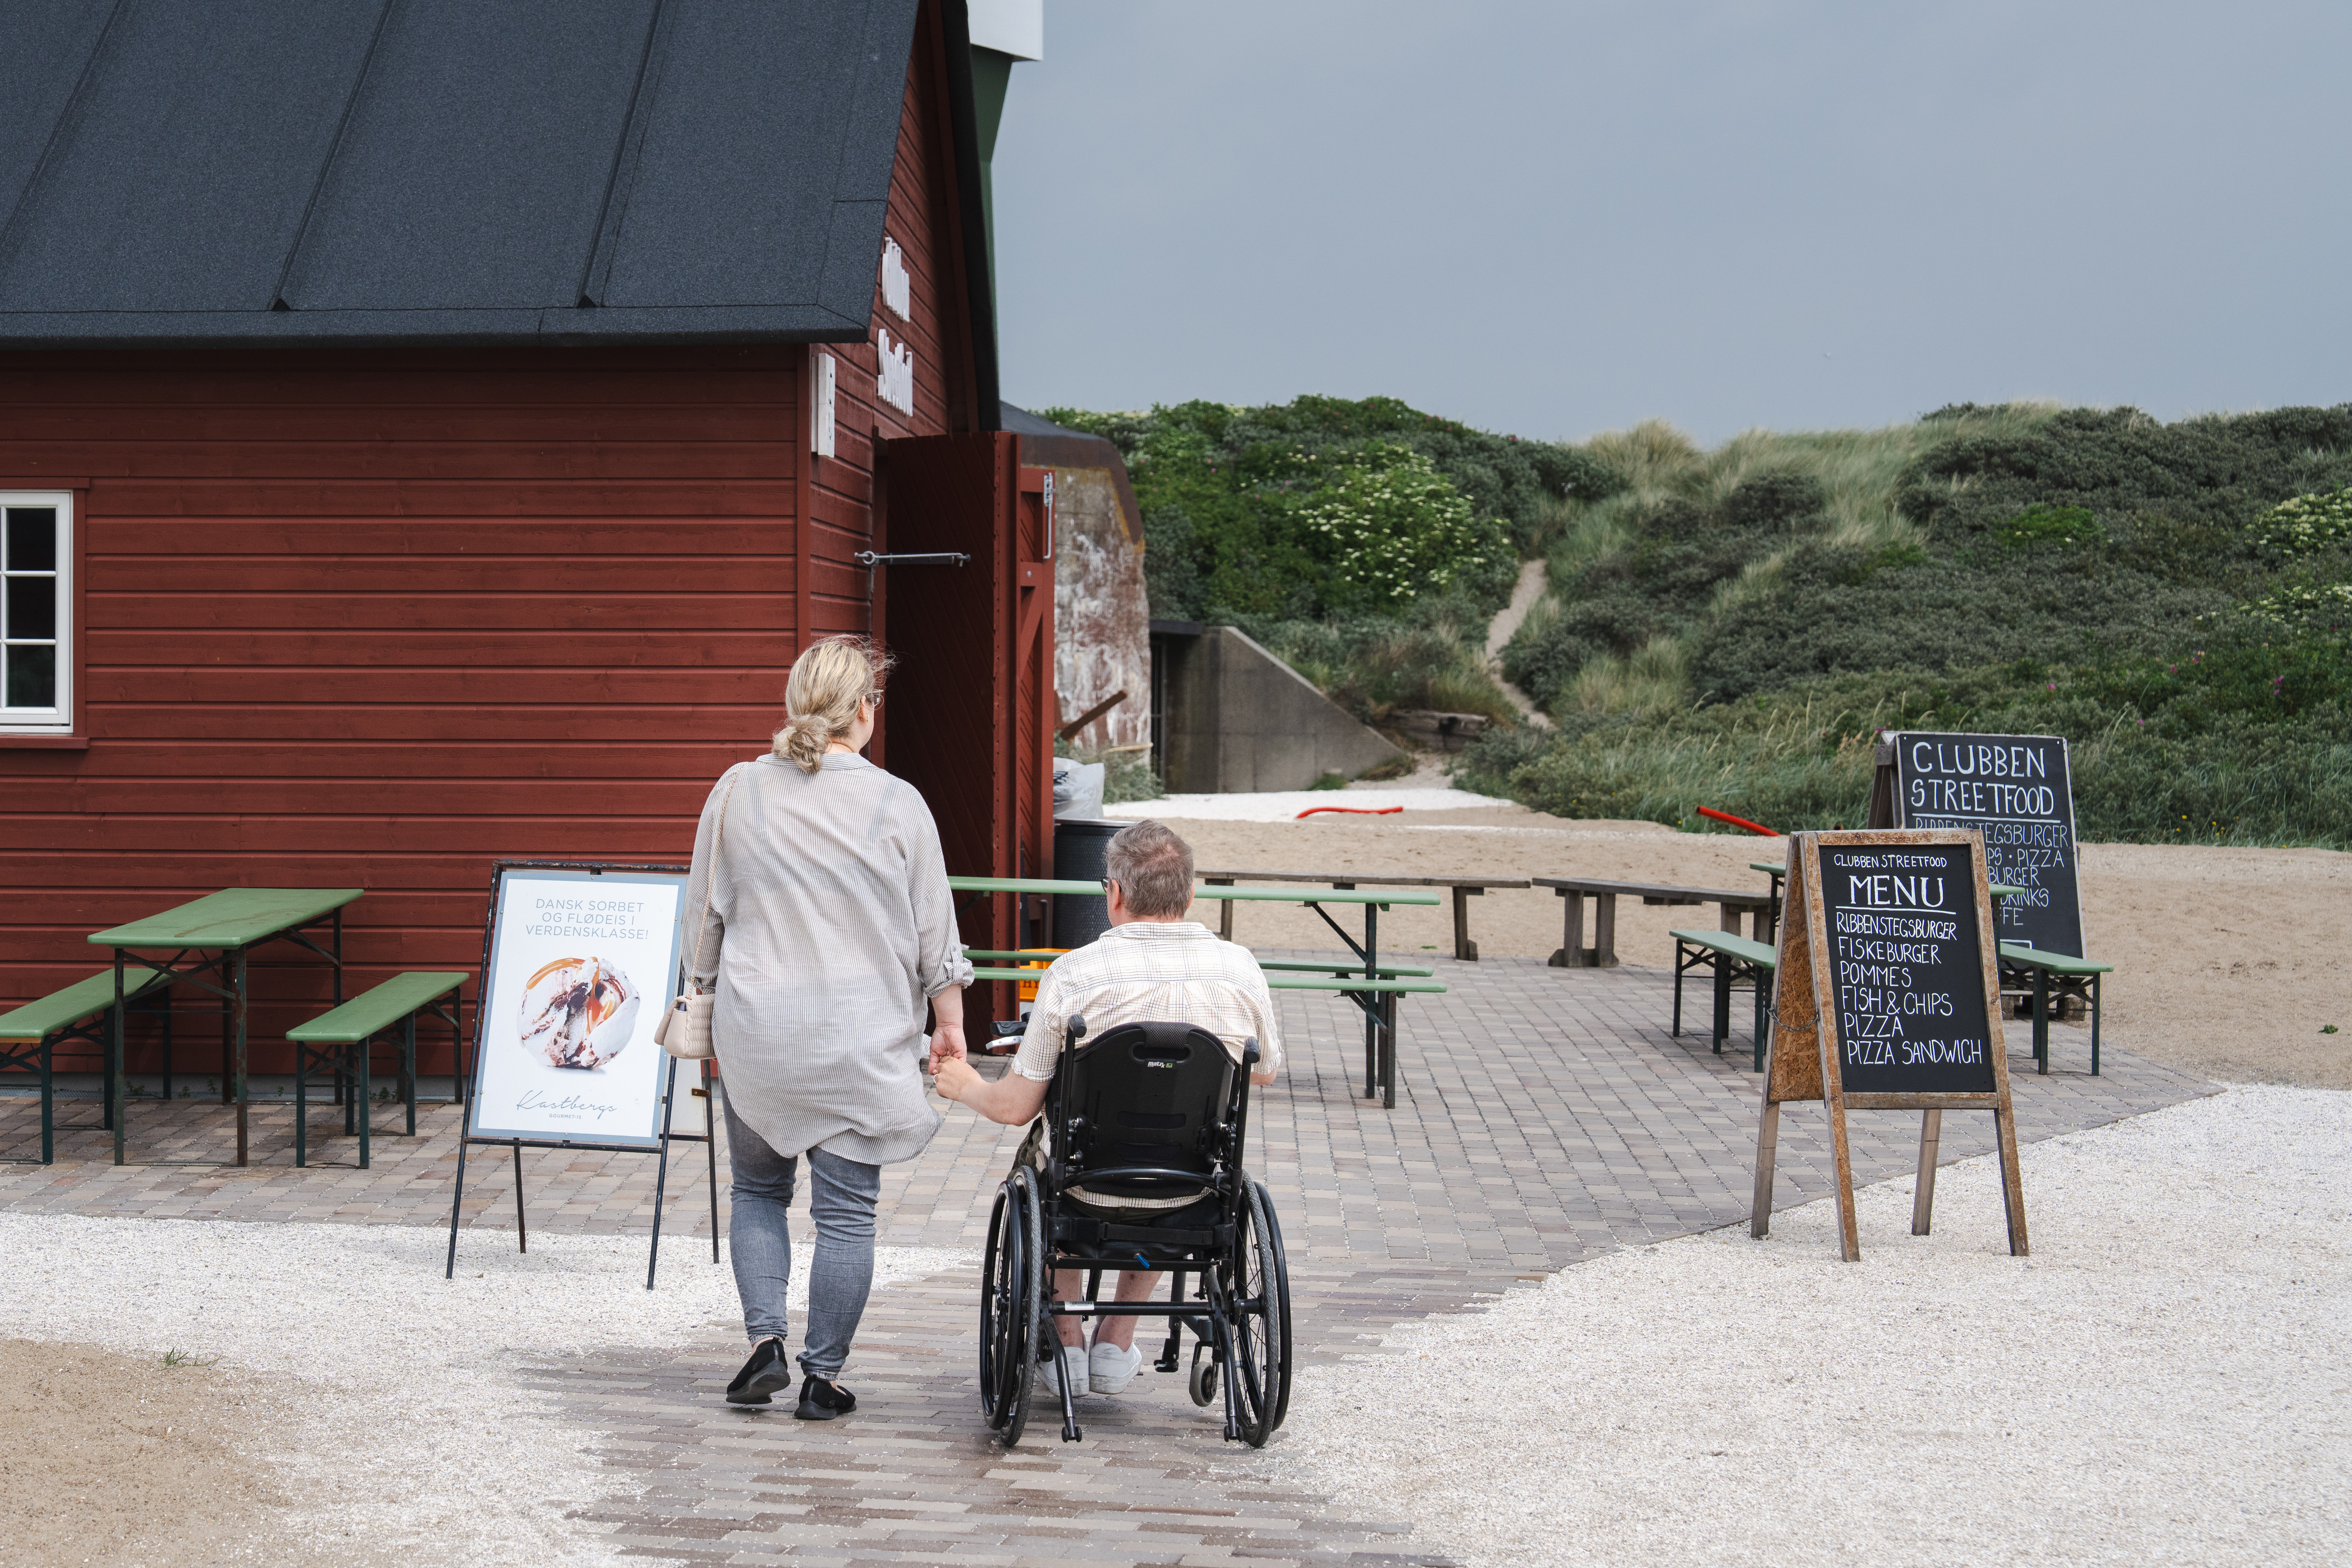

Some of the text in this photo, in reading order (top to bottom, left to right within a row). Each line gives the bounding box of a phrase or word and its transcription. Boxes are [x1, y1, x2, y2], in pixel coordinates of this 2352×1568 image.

[1912, 741, 2045, 778] CLUBBEN
[1911, 778, 2054, 815] STREETFOOD
[1834, 854, 1947, 868] CLUBBEN STREETFOOD
[2017, 848, 2065, 868] PIZZA
[1849, 875, 1944, 907] MENU
[536, 899, 645, 912] DANSK SORBET
[542, 912, 635, 925] OG FLØDEIS I
[526, 924, 648, 939] VERDENSKLASSE!
[1836, 911, 1957, 941] RIBBENSTEGSBURGER
[1839, 936, 1942, 964] FISKEBURGER
[1840, 960, 1912, 987] POMMES
[1842, 986, 1953, 1016] FISH & CHIPS
[1844, 1013, 1904, 1037] PIZZA
[1847, 1039, 1983, 1065] PIZZA SANDWICH
[516, 1090, 618, 1120] Kastbergs
